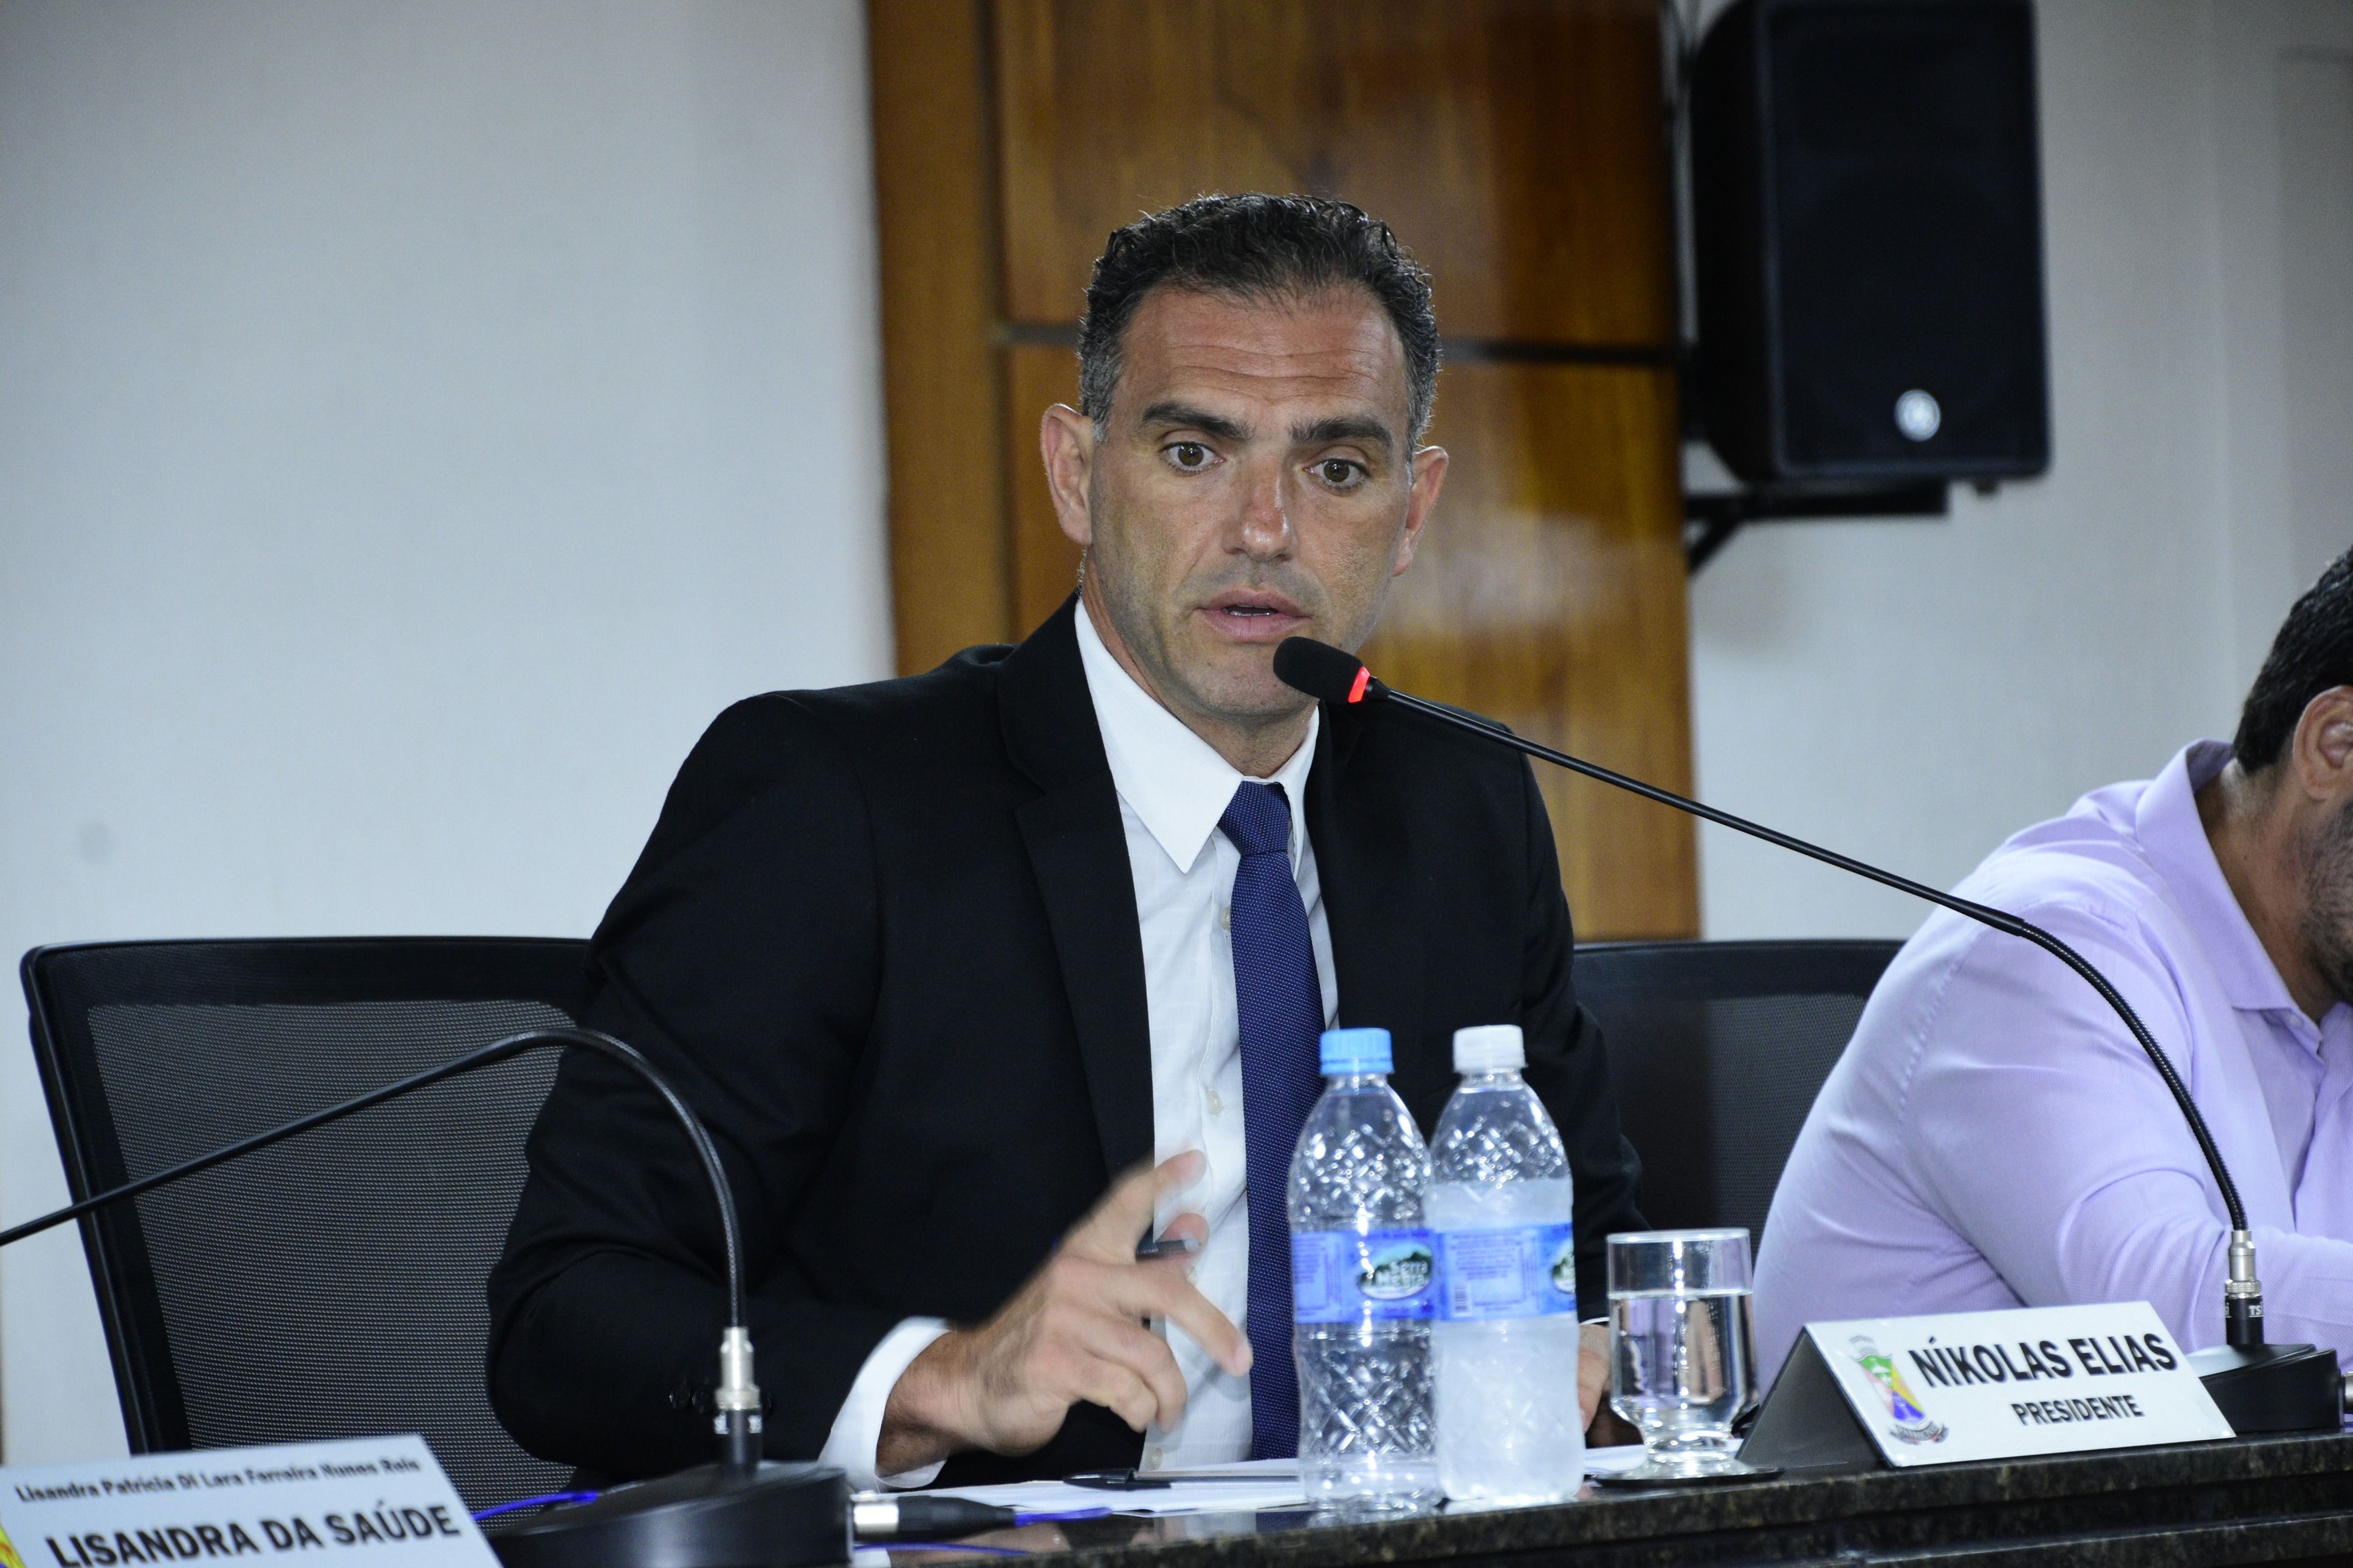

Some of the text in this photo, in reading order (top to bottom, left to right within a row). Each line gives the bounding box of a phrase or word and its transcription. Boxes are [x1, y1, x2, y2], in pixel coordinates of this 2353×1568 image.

[1375, 1270, 1424, 1287] Negra
[1390, 1260, 1428, 1275] Serra
[1908, 1333, 2179, 1388] NÍKOLAS ELIAS
[2010, 1395, 2146, 1426] PRESIDENTE
[15, 1482, 100, 1502] Lisandra
[200, 1470, 244, 1487] Lara
[245, 1466, 318, 1483] Ferreira
[319, 1461, 378, 1479] Nunes
[380, 1456, 421, 1474] Reis
[45, 1498, 462, 1568] LISANDRA DA SAÚDE
